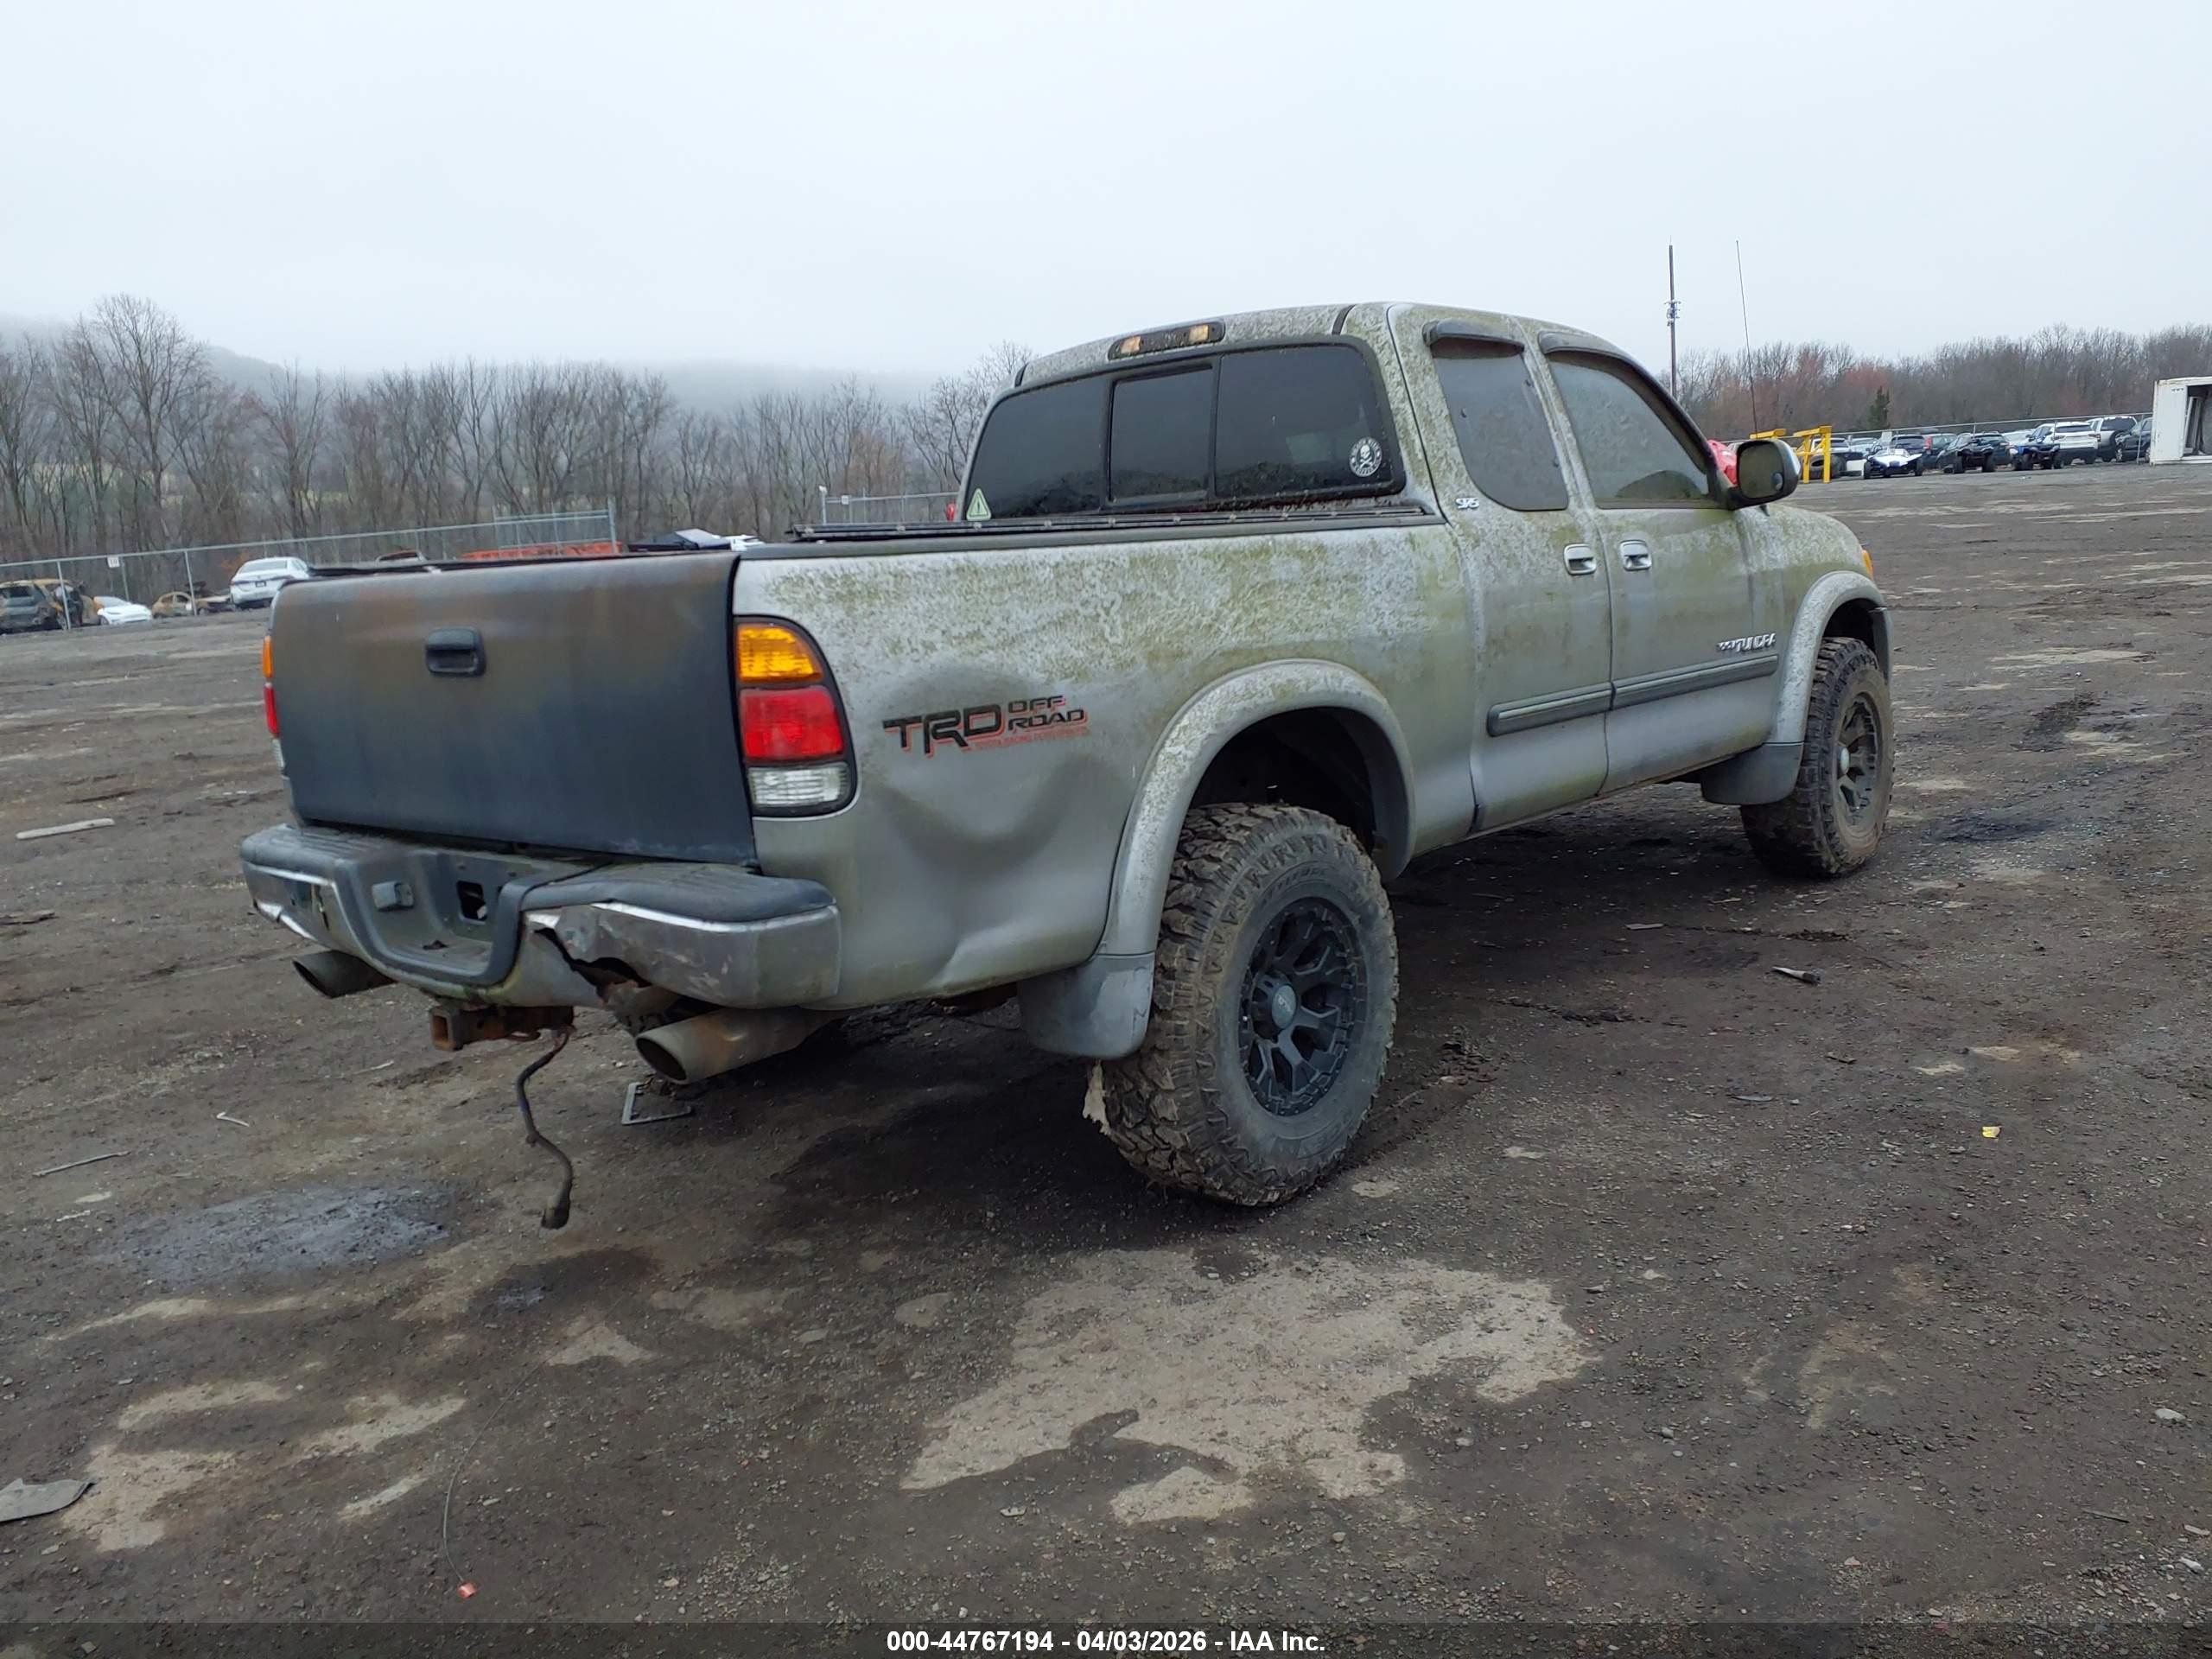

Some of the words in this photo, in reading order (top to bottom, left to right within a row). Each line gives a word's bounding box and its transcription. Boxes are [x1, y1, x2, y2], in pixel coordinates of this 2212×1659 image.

[1007, 695, 1066, 715] OFF
[881, 703, 1005, 758] TRD
[1007, 708, 1089, 733] ROAD
